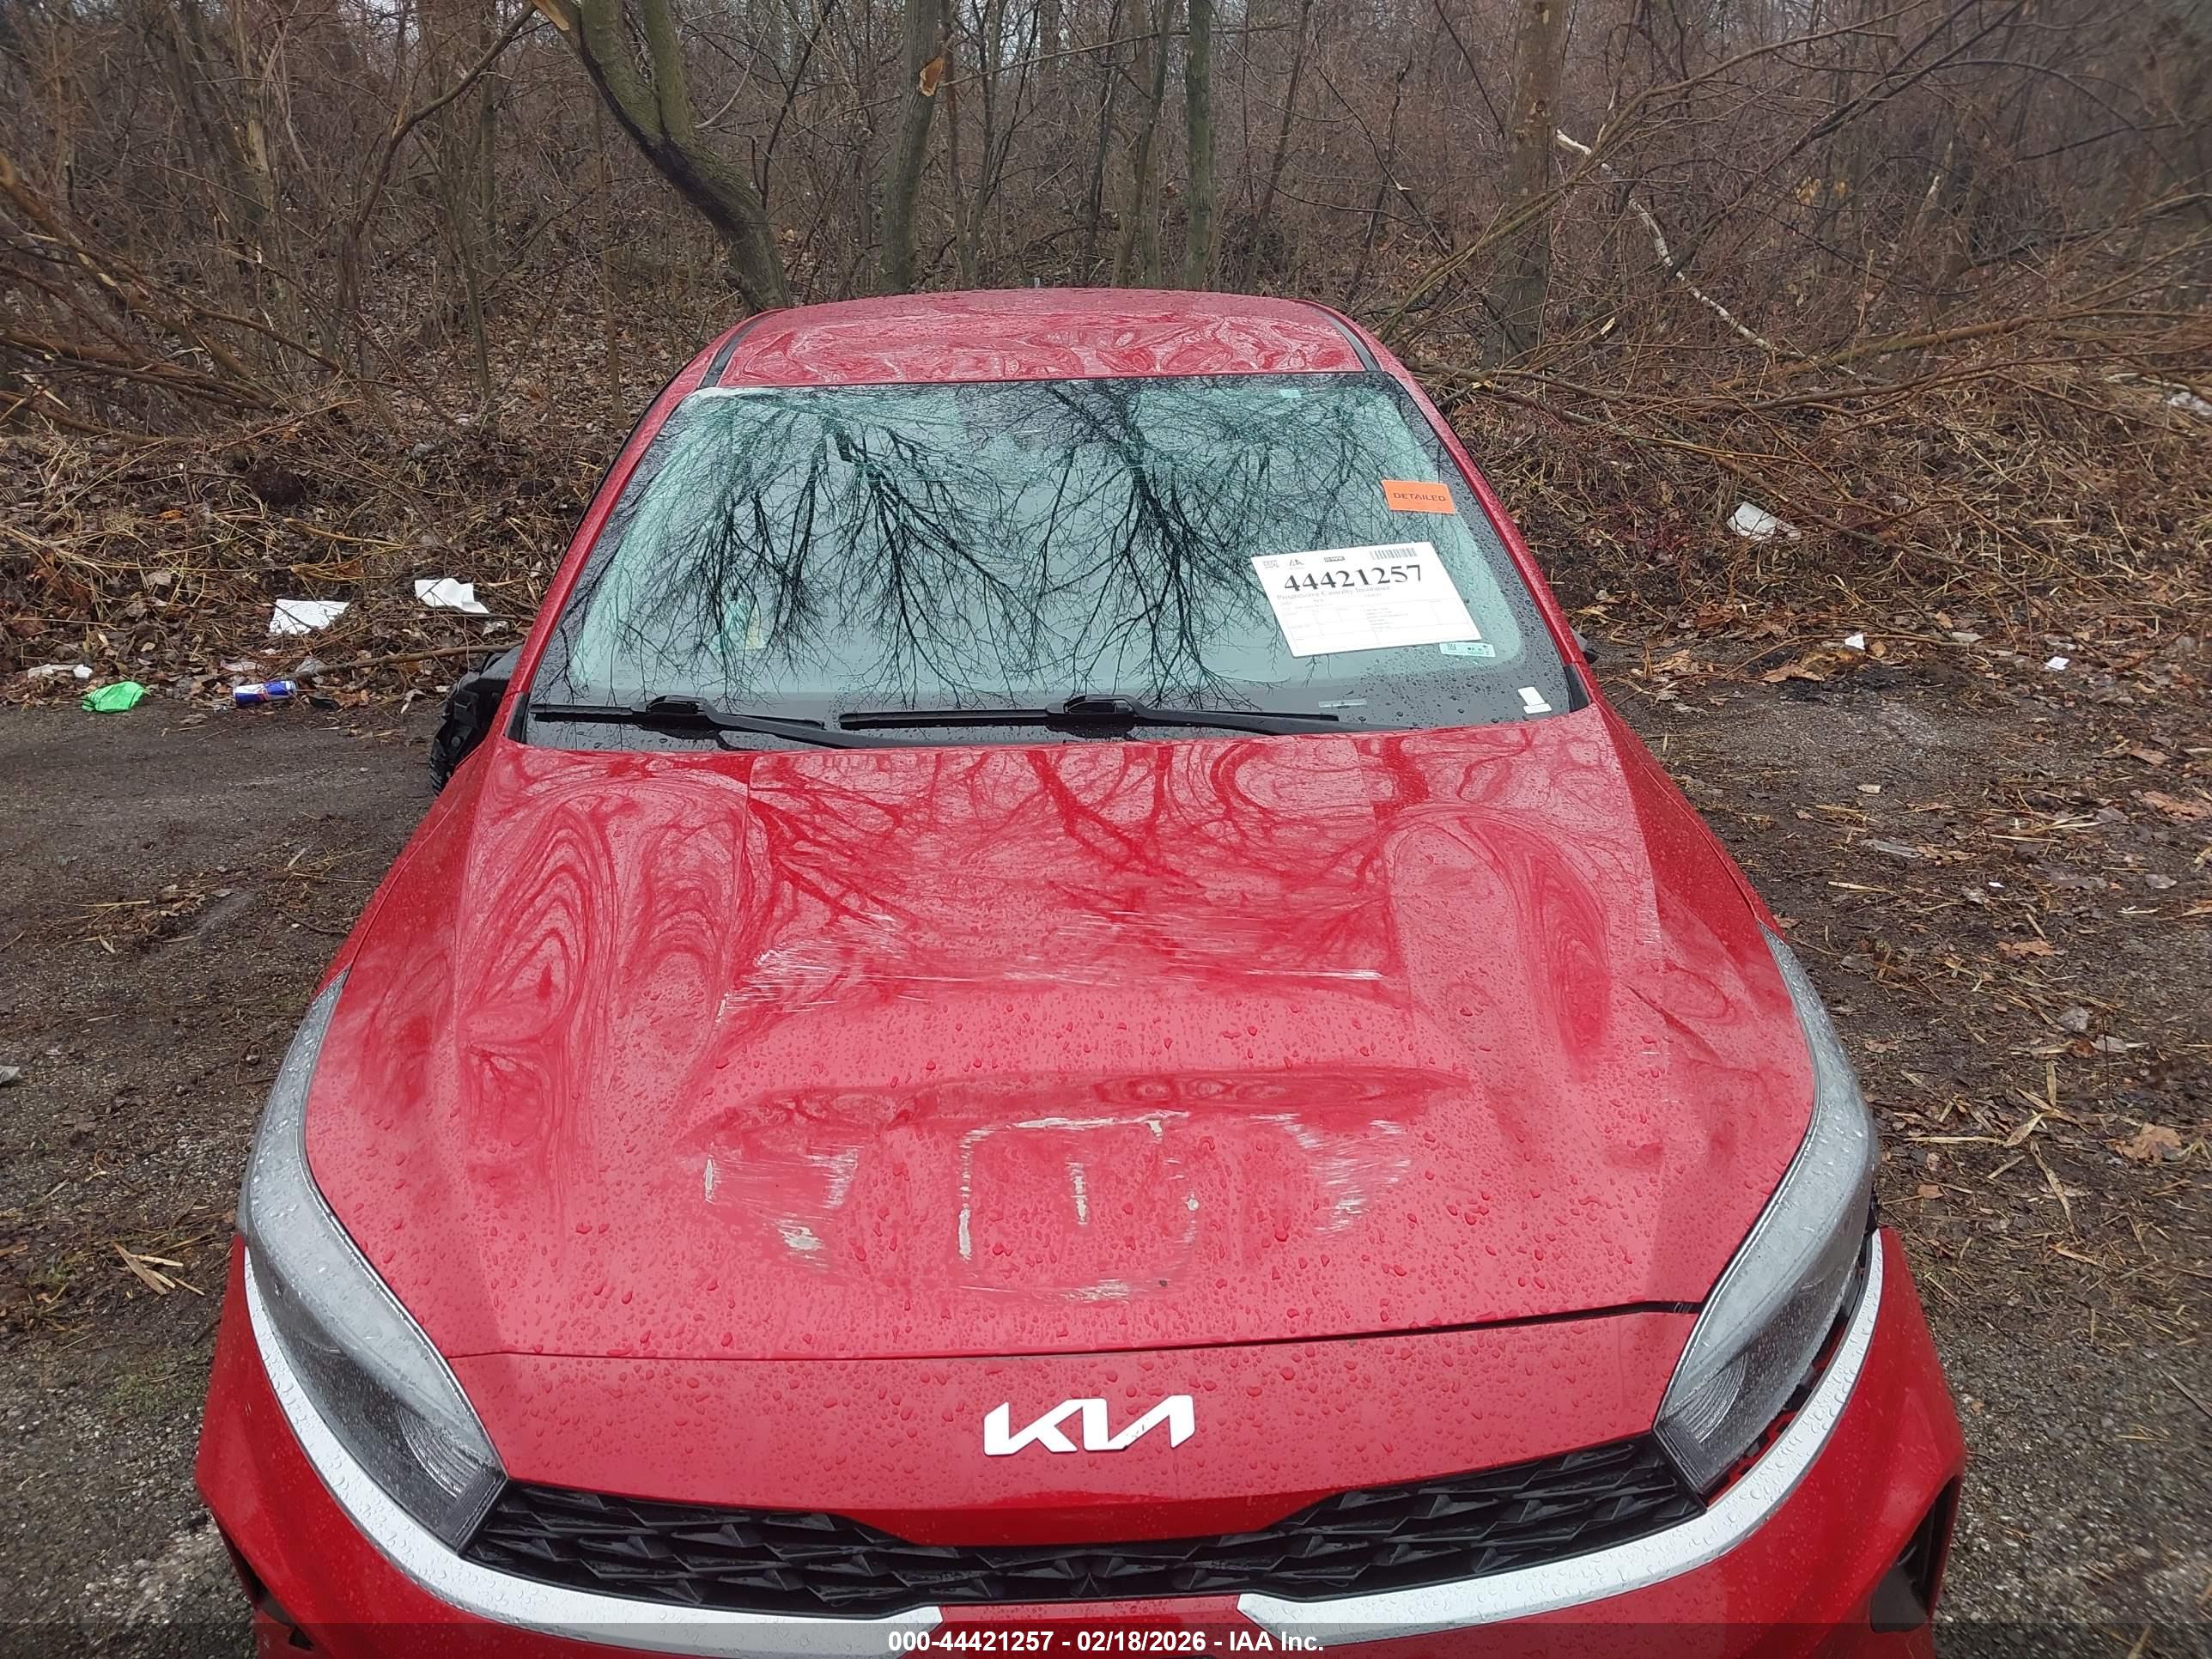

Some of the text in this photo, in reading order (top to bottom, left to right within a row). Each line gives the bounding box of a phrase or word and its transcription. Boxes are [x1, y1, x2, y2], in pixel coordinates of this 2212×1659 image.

[1393, 492, 1446, 501] DETAILED
[1285, 565, 1422, 592] 44421257
[983, 1395, 1195, 1455] KIA
